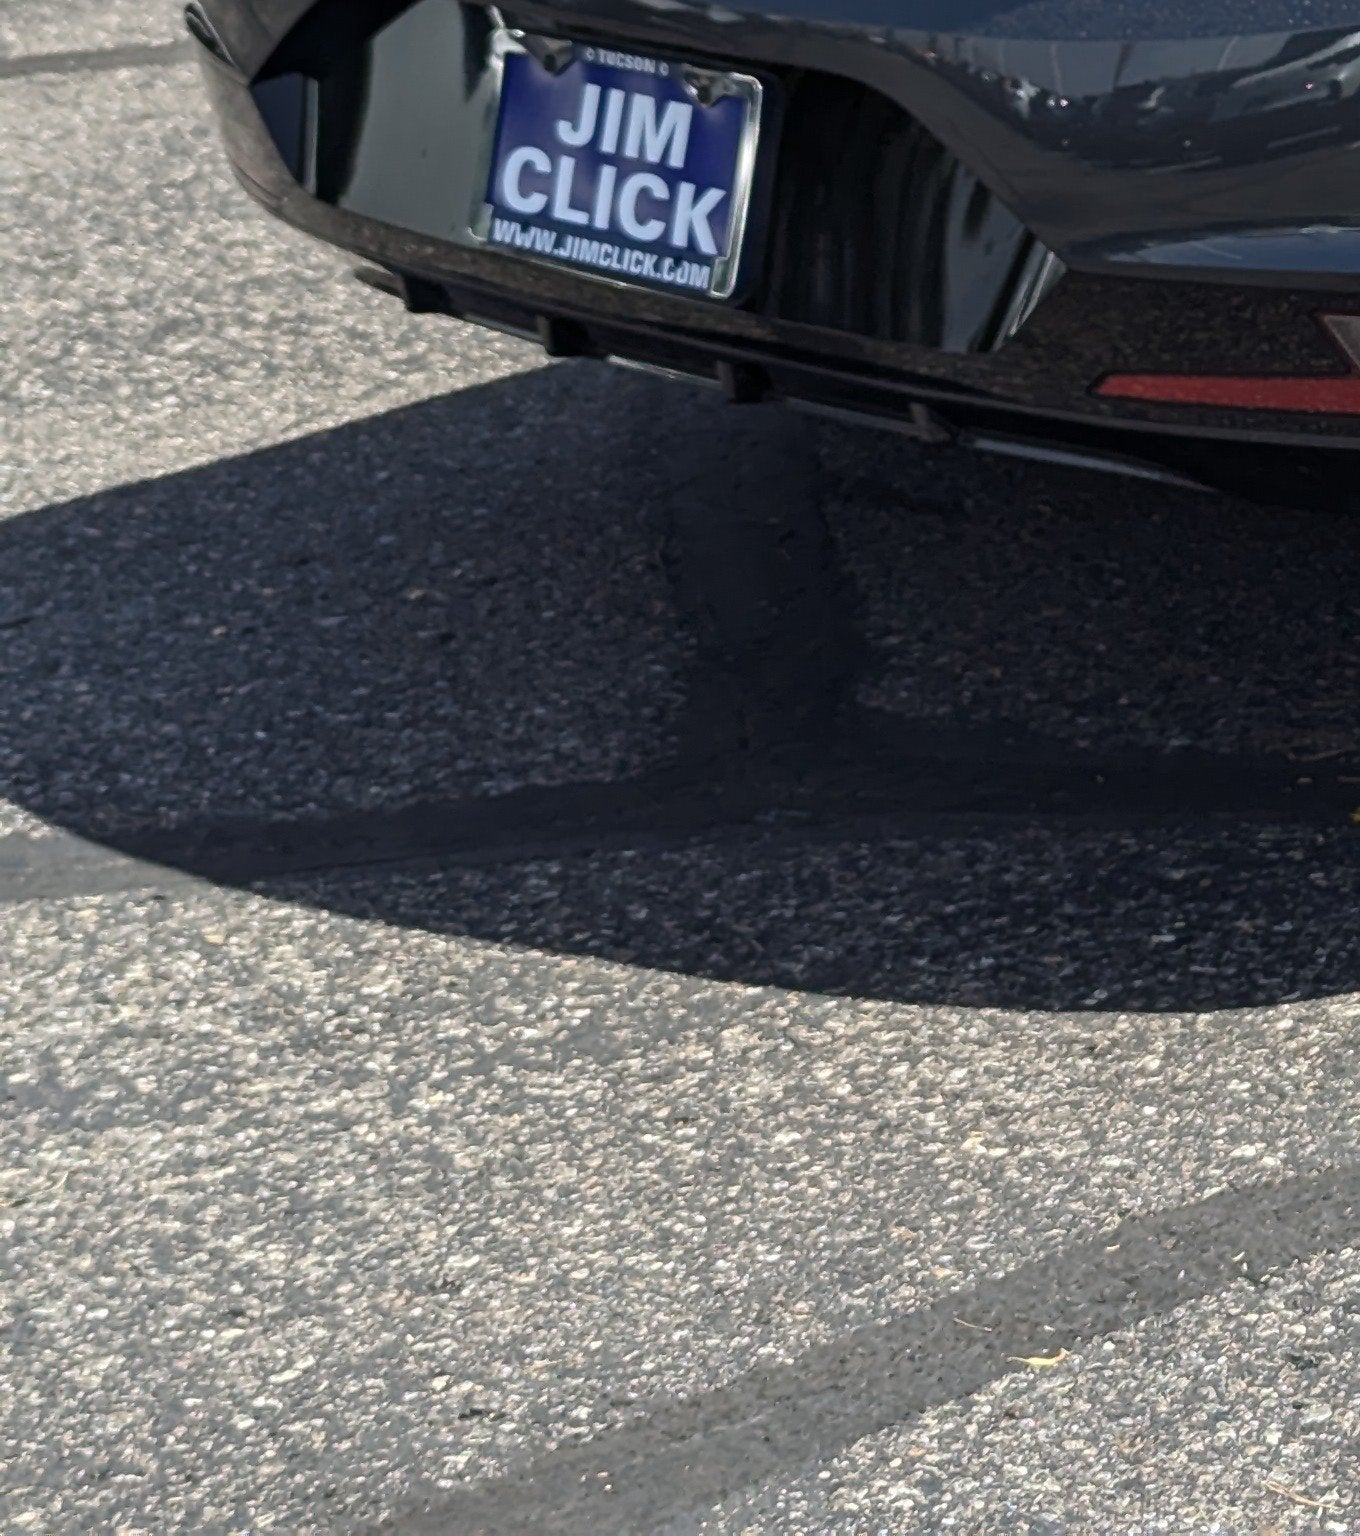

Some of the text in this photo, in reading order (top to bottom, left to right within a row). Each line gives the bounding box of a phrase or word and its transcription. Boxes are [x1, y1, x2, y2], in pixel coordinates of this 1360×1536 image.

[598, 48, 656, 74] TUCSON
[555, 82, 693, 169] JIM
[501, 145, 727, 256] CLICK
[492, 217, 711, 290] WWW.JIMCLICK.COM
